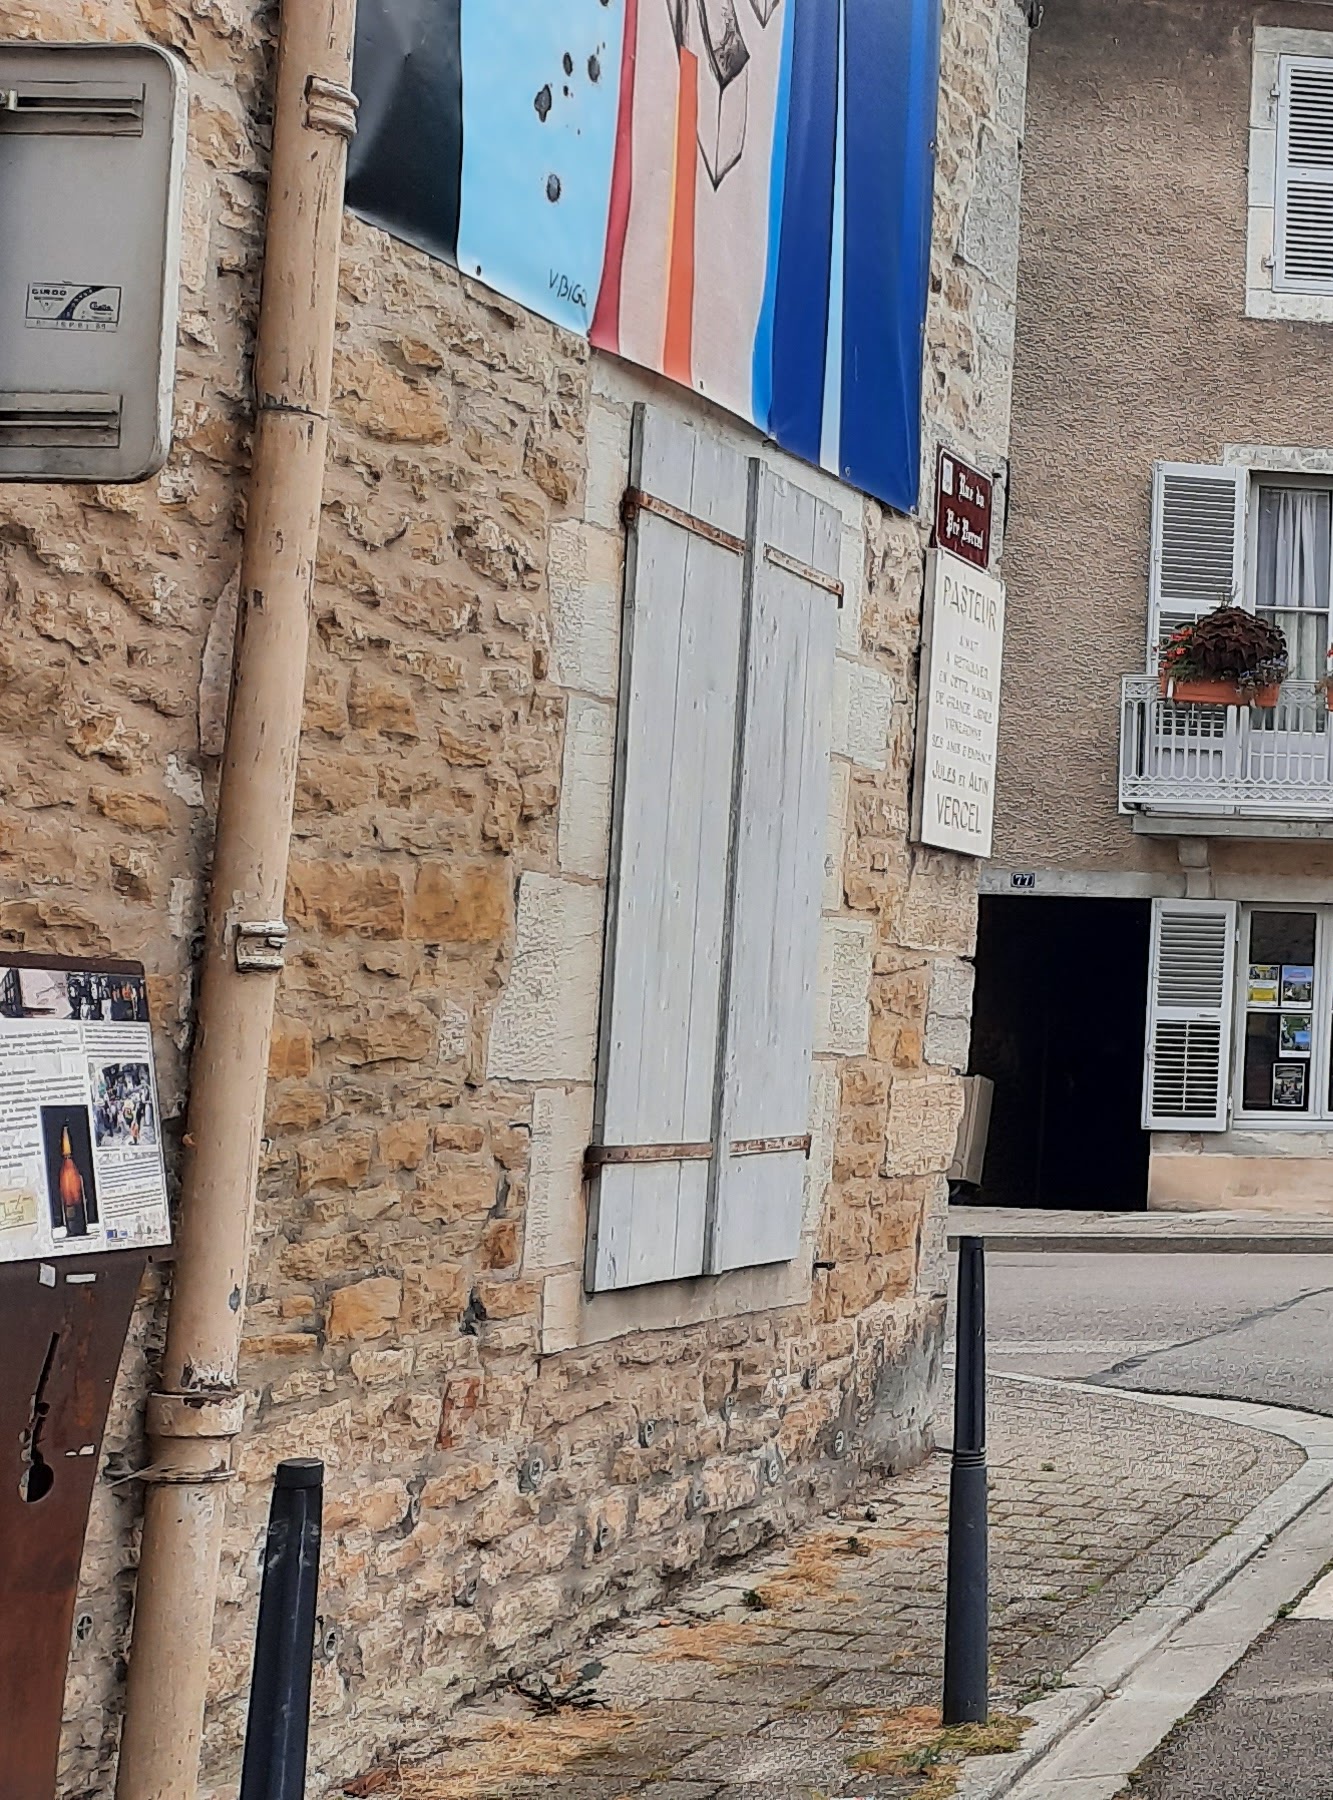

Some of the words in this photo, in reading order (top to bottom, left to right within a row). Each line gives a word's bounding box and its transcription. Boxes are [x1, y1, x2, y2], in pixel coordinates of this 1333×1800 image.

[943, 575, 997, 632] PASTEUR
[932, 760, 956, 785] JULES
[936, 793, 982, 834] VERCEL
[1015, 874, 1031, 886] 77
